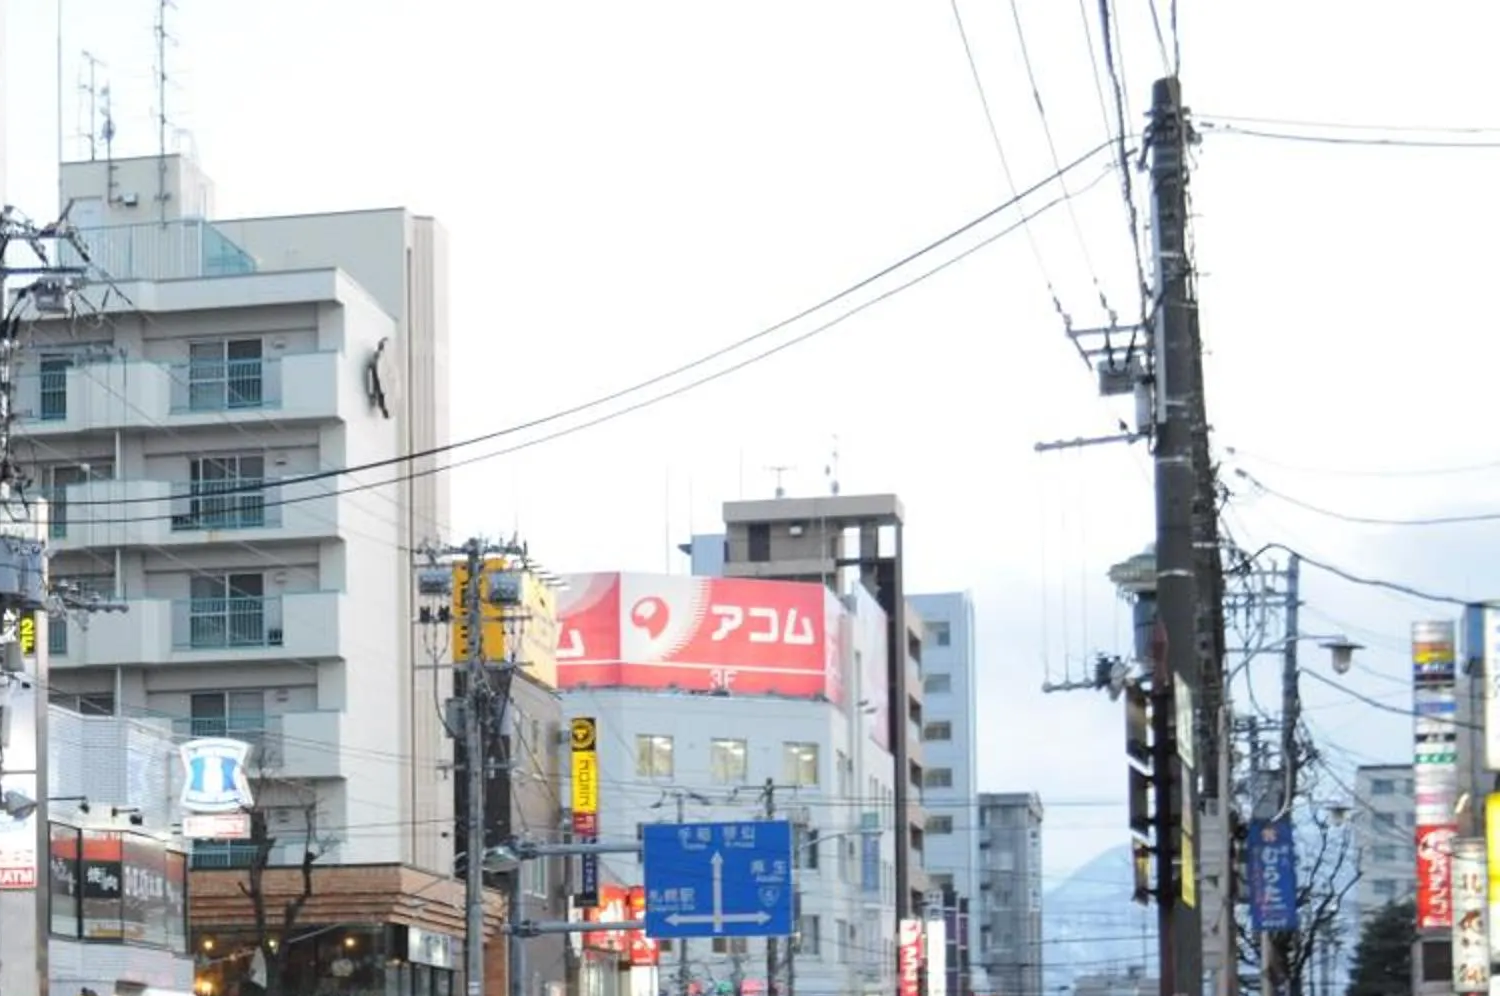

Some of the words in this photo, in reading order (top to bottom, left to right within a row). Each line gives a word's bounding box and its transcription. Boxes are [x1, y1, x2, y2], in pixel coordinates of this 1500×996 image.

[710, 605, 815, 645] アコム
[709, 669, 736, 688] 3F
